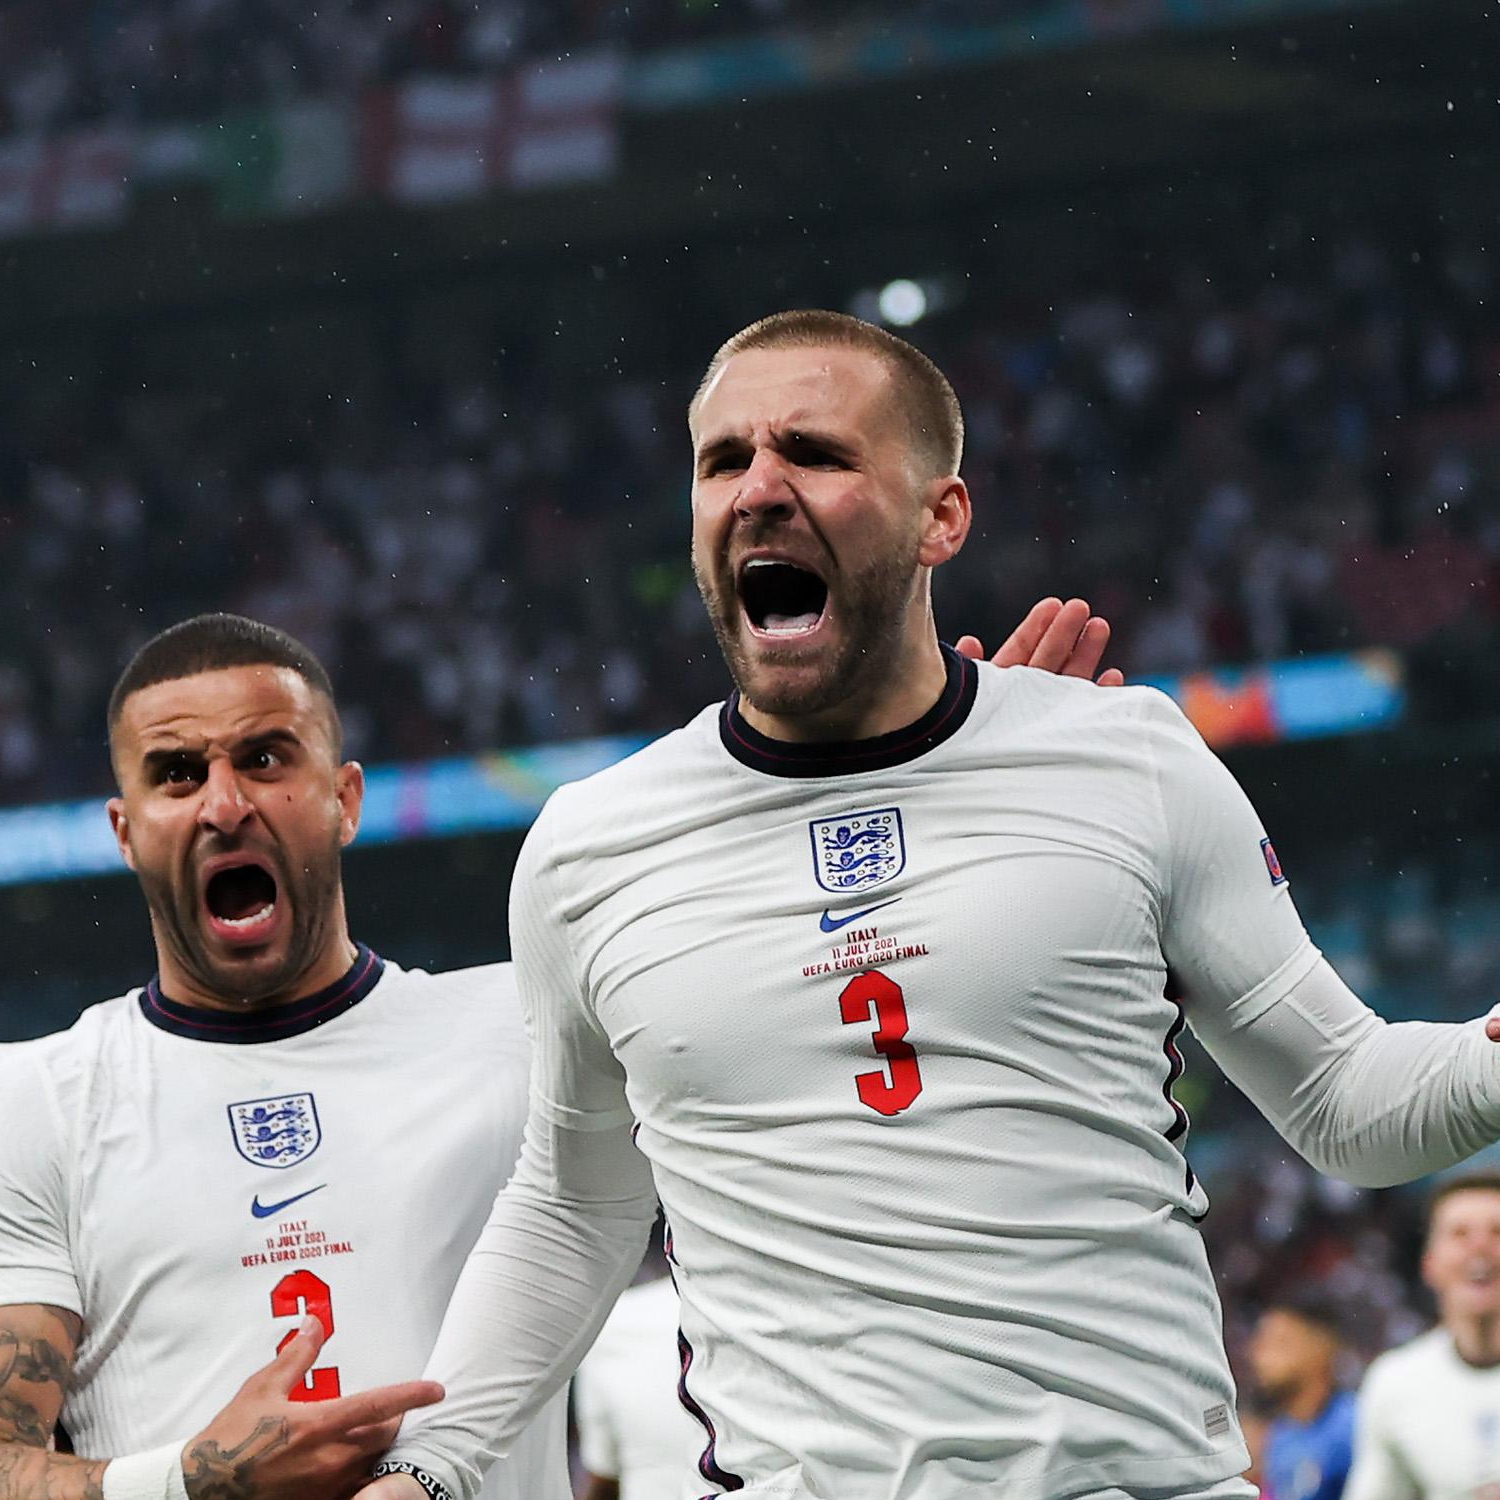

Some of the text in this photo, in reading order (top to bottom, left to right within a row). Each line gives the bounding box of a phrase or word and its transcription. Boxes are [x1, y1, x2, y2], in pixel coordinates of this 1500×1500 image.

[847, 927, 877, 943] ITALY
[832, 937, 898, 959] 11 JULY 2021
[803, 944, 929, 976] UEFA EURO 2020 FINAL
[838, 970, 923, 1117] 3
[279, 1220, 308, 1233] ITALY
[277, 1234, 301, 1248] JULY
[305, 1231, 327, 1244] 2021
[241, 1242, 354, 1267] UEFA EURO 2020 FINAL
[270, 1269, 341, 1403] 2
[417, 1471, 437, 1494] TO
